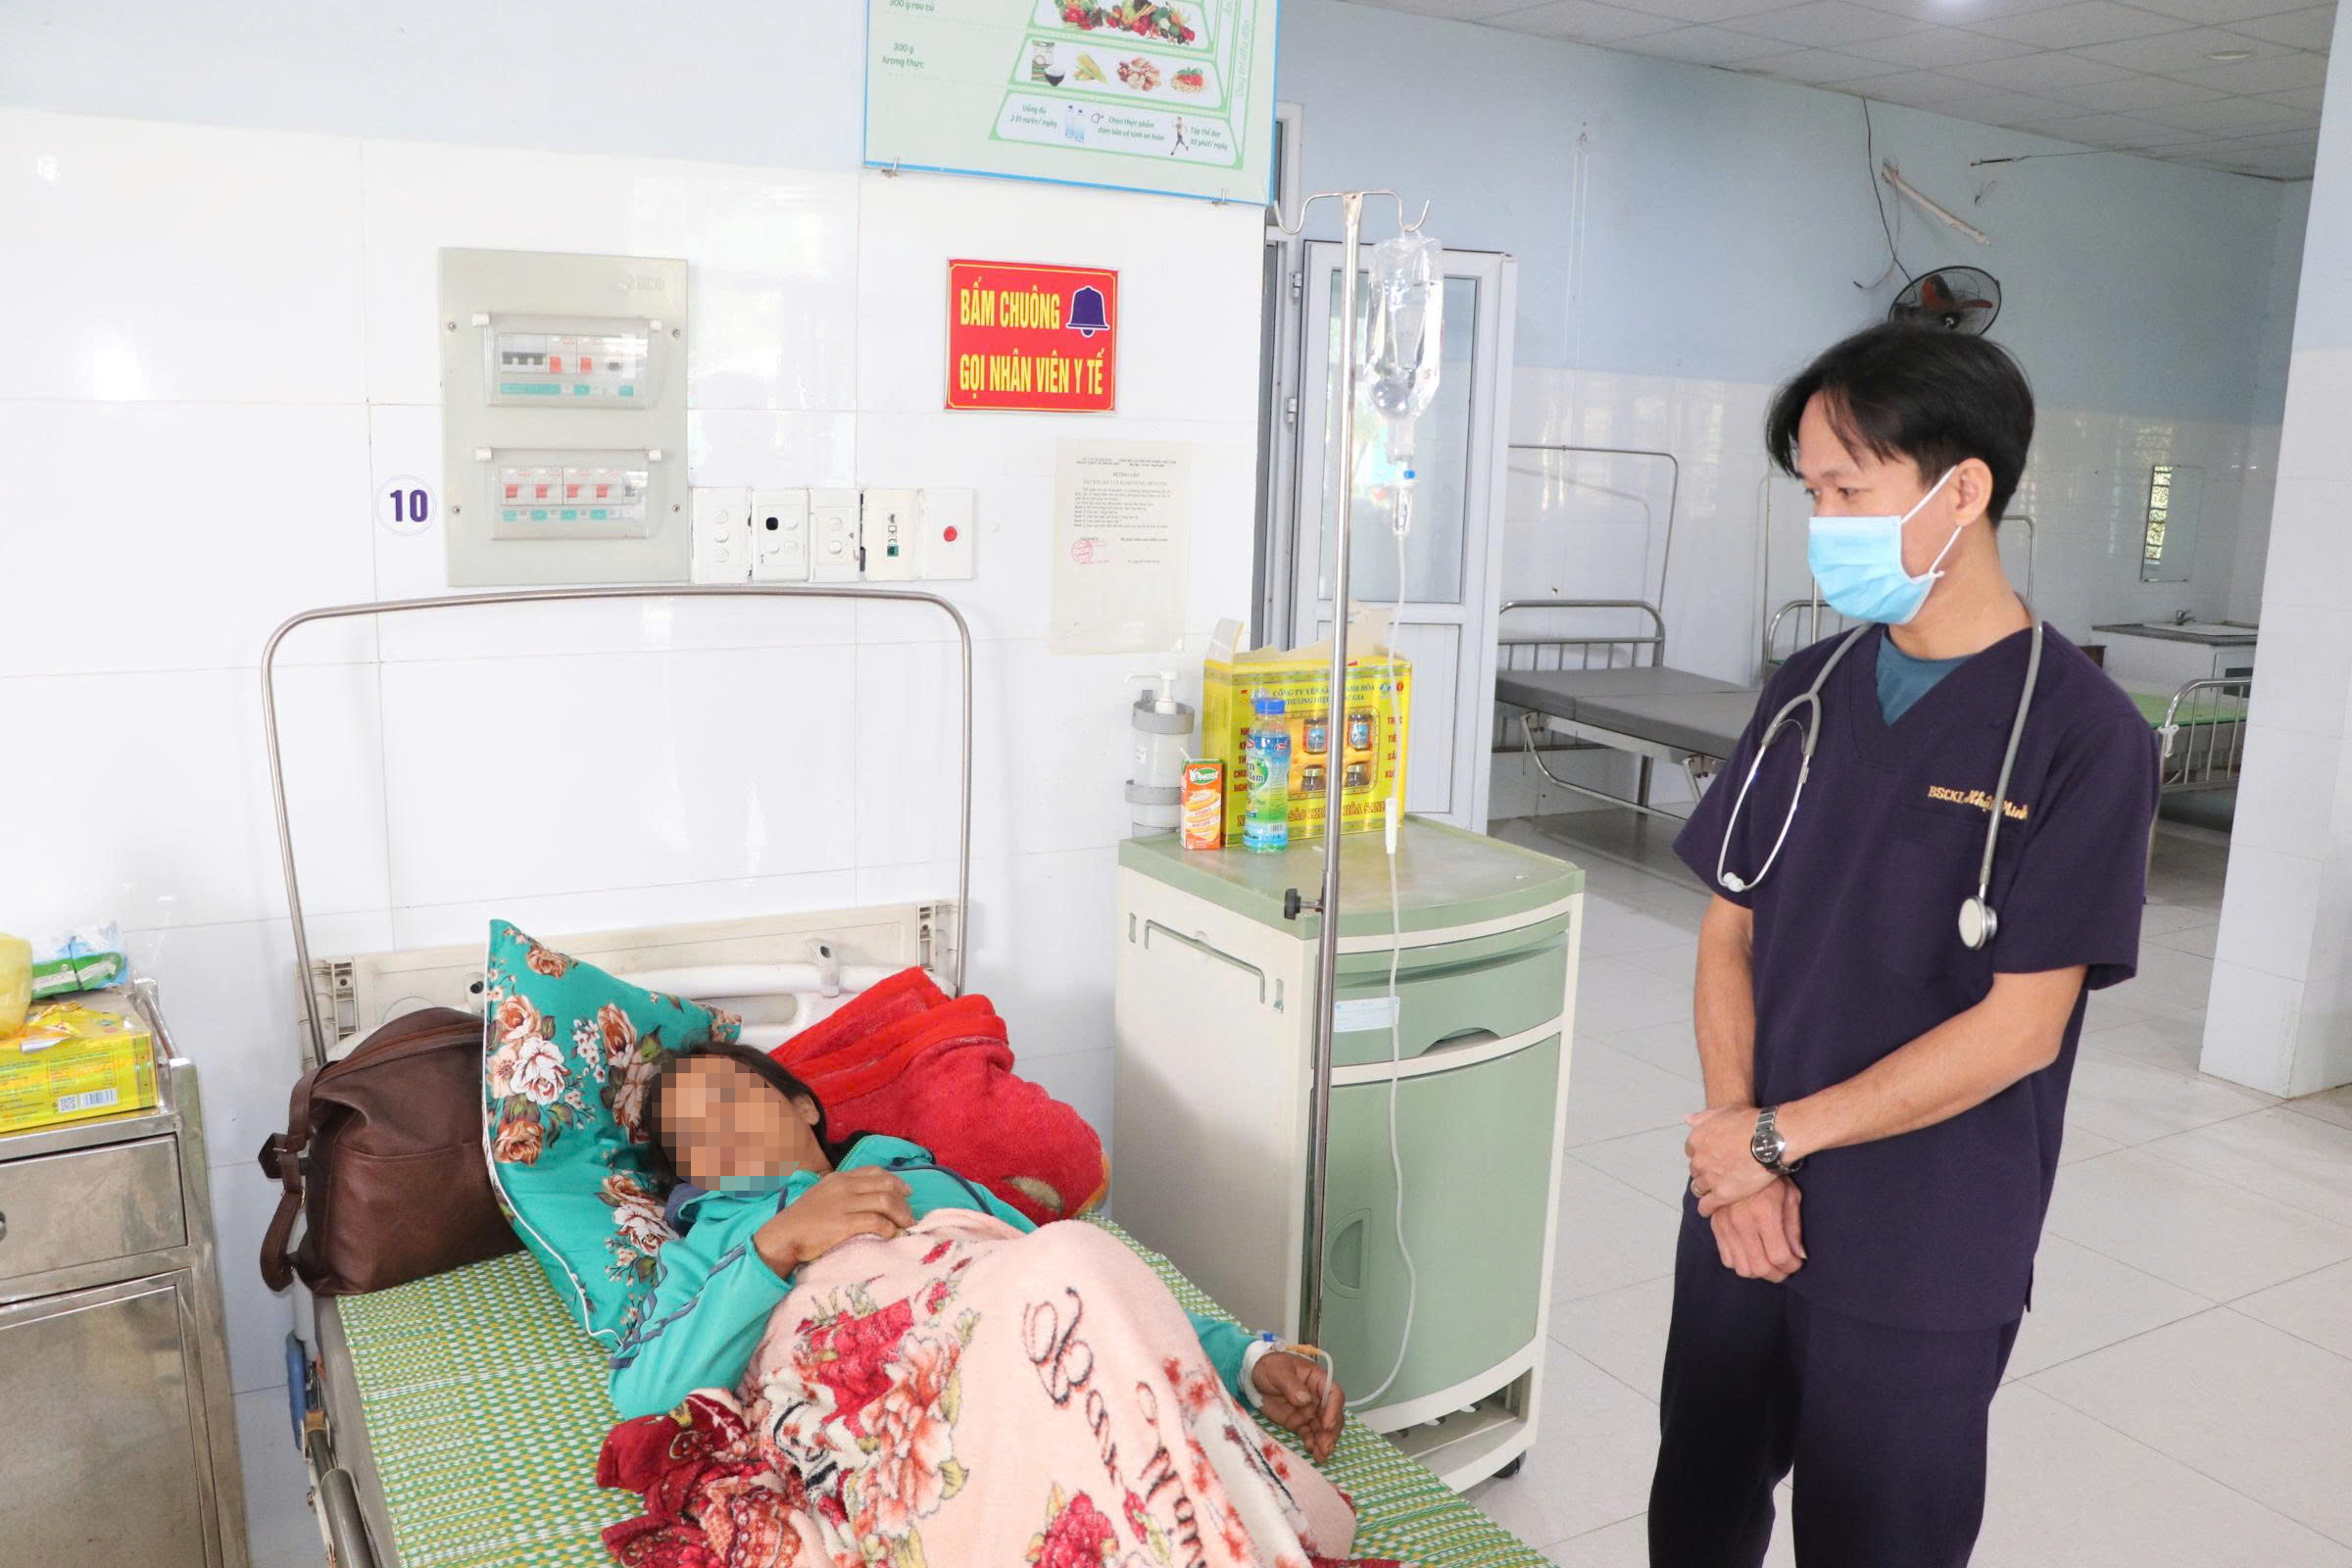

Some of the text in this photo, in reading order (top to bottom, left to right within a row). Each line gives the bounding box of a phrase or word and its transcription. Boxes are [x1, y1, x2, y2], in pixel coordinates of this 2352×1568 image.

[959, 276, 1060, 330] BẤM CHUÔNG
[959, 348, 1105, 400] GỌI NHÂN VIÊN Y TẾ
[389, 488, 429, 523] 10
